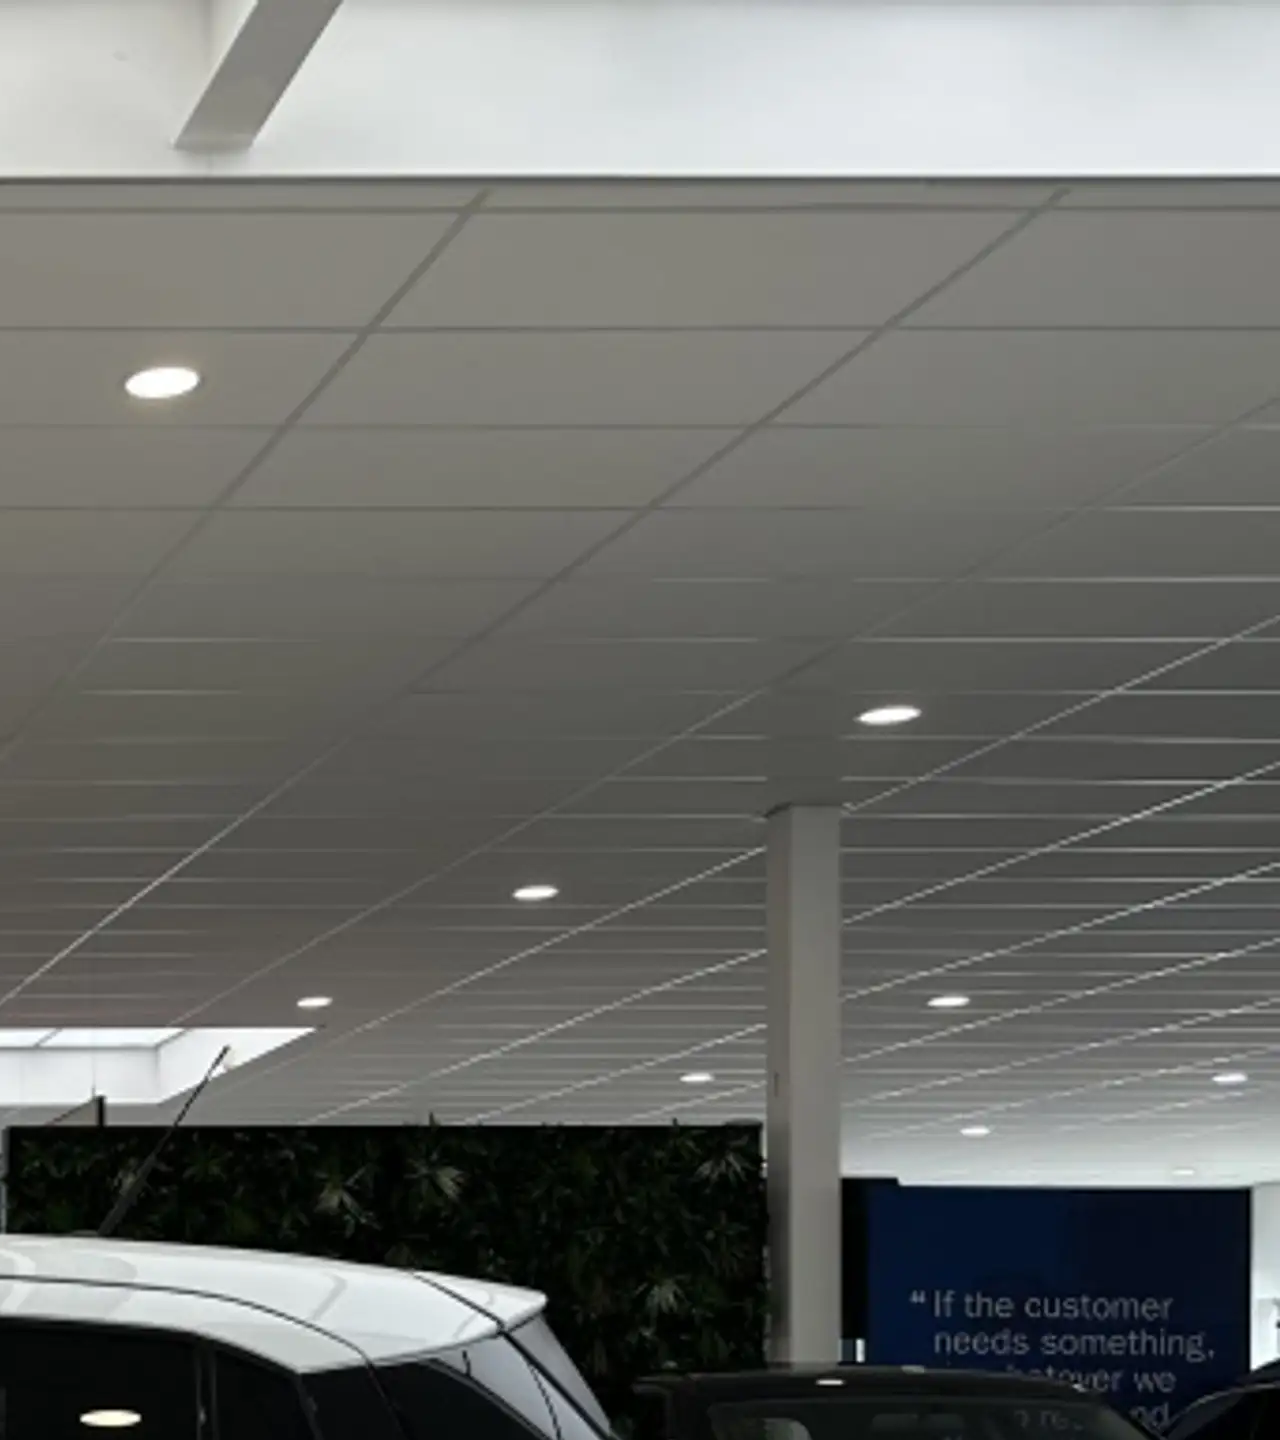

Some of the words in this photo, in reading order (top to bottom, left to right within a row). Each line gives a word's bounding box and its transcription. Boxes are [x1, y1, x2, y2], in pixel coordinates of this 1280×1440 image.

[964, 1292, 1014, 1319] the
[1024, 1296, 1174, 1321] customer
[934, 1328, 1029, 1355] needs
[1040, 1328, 1215, 1363] something,
[1133, 1372, 1177, 1393] we
